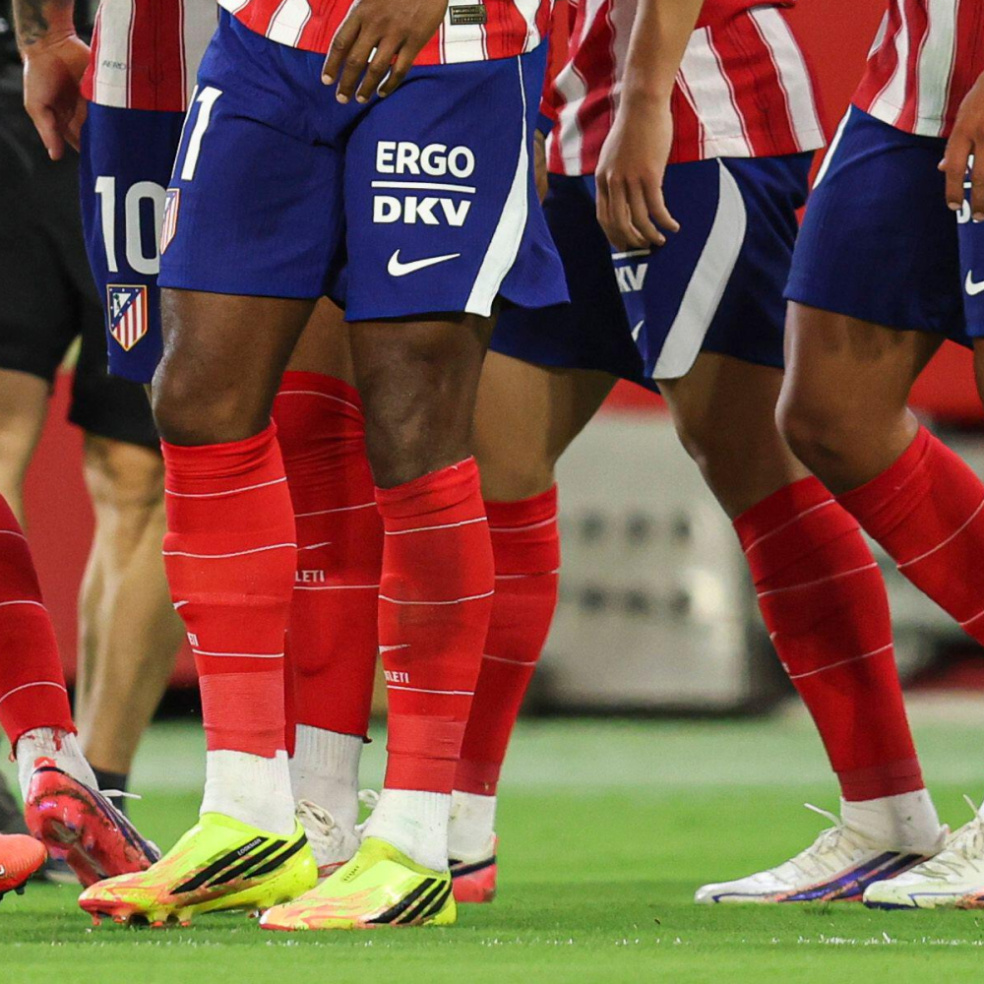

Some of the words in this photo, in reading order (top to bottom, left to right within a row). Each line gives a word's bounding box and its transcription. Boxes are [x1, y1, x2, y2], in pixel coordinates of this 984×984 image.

[376, 141, 475, 178] ERGO
[95, 176, 167, 275] 10
[373, 195, 471, 227] DKV
[295, 569, 326, 583] LETI
